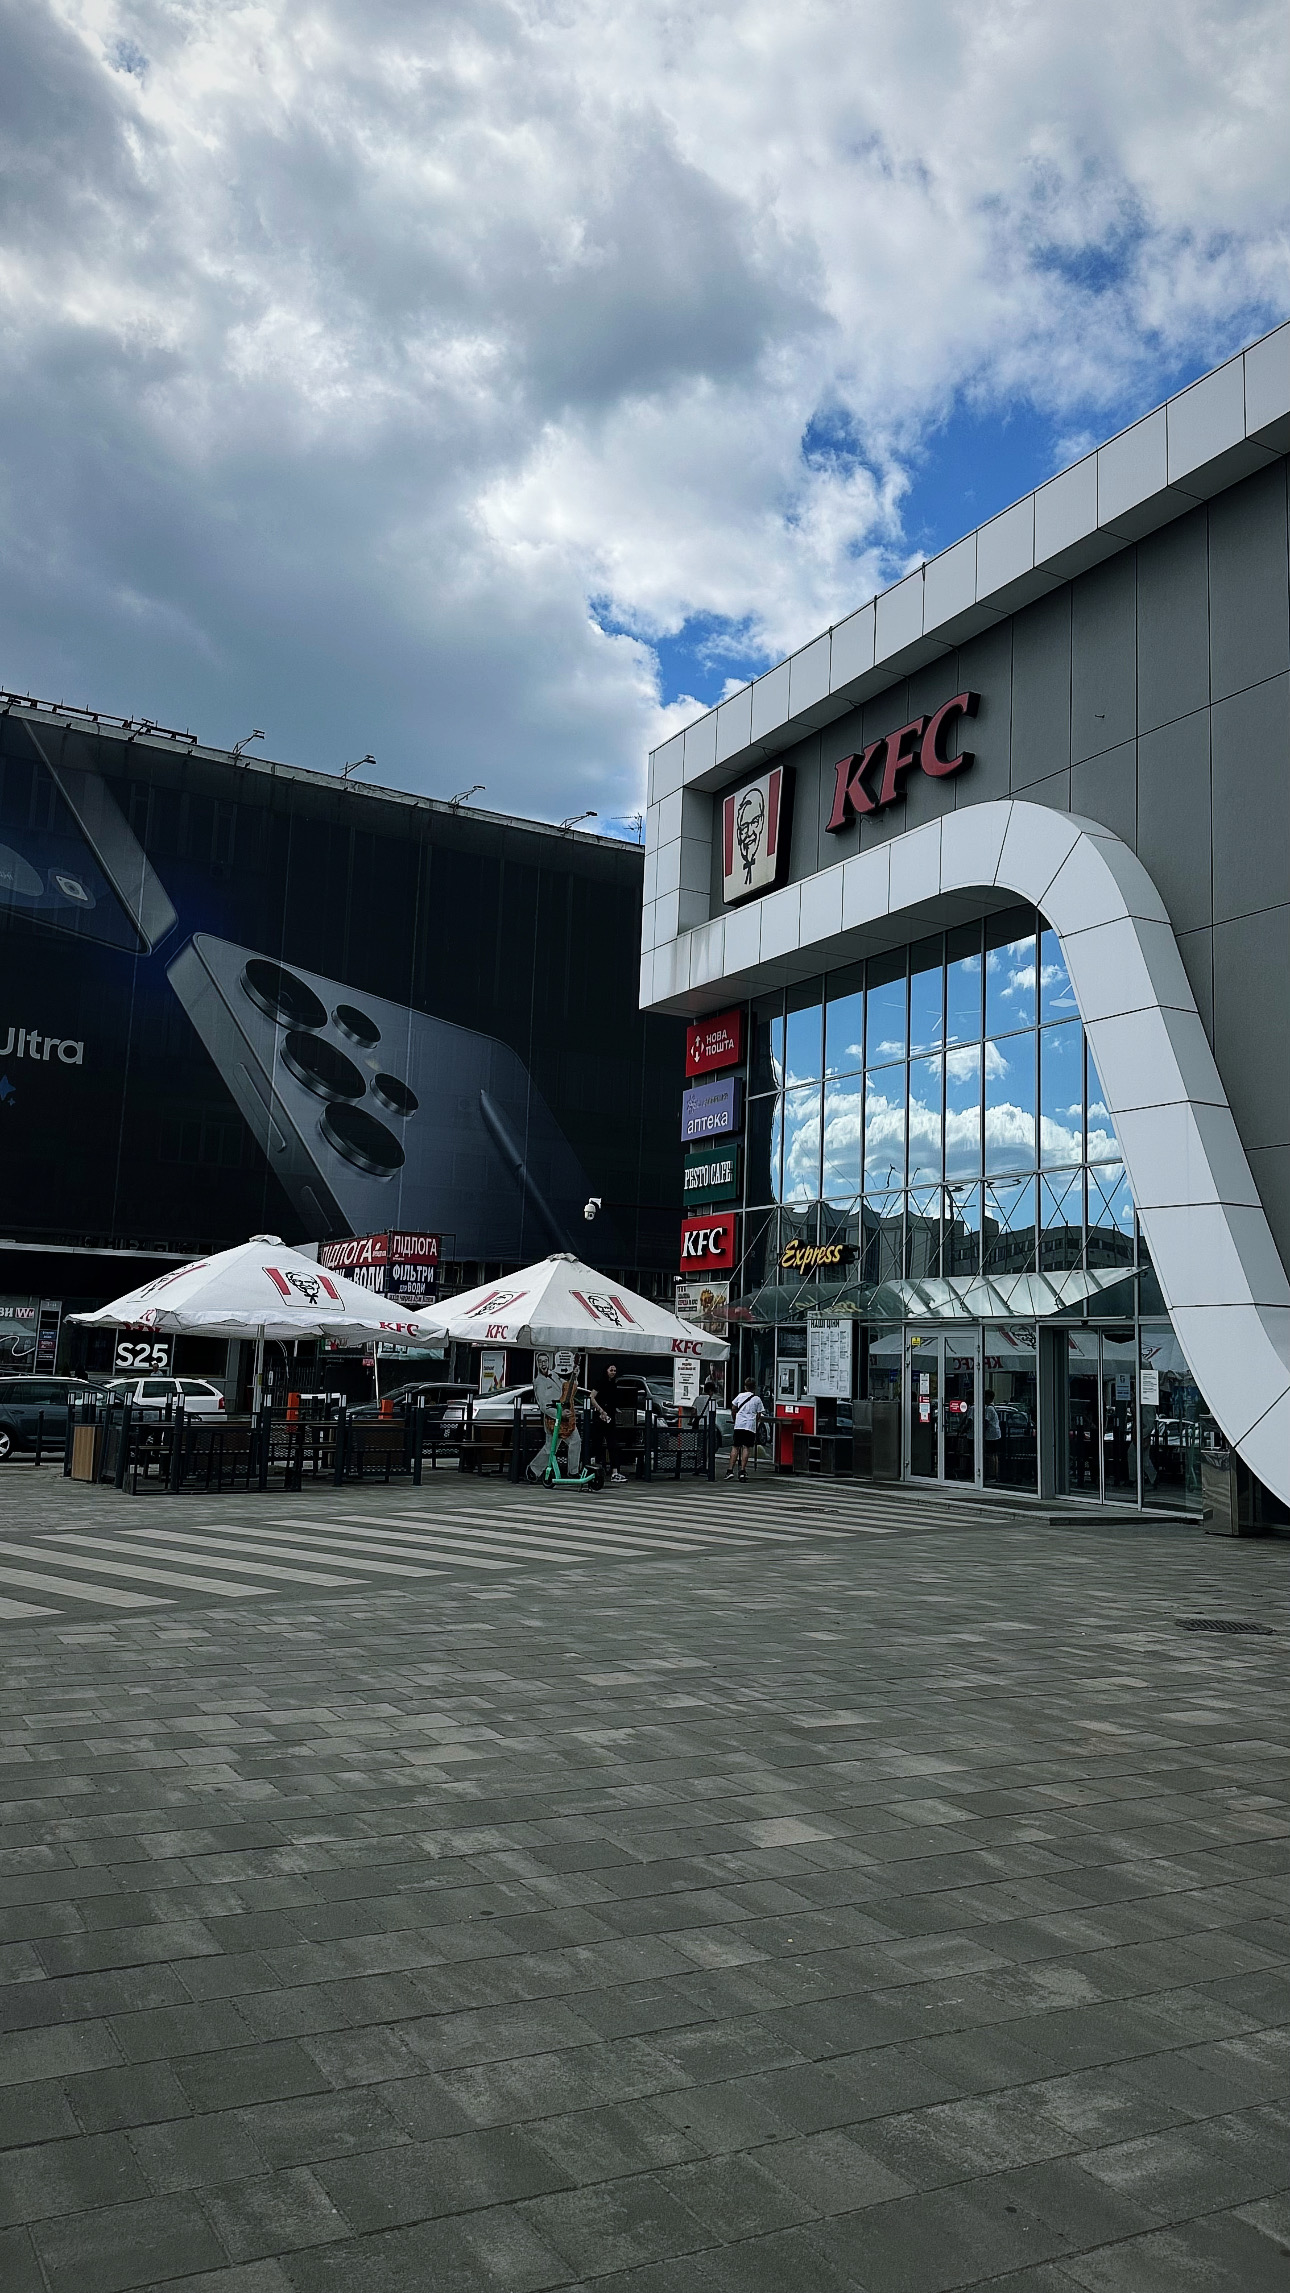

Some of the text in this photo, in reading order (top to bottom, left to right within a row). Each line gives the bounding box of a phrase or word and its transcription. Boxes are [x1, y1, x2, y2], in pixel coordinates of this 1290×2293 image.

[825, 690, 979, 833] KFC
[705, 1029, 728, 1045] НОВА
[705, 1038, 735, 1057] ПОШТА
[687, 1111, 728, 1135] аптека
[683, 1160, 733, 1190] PESTO CAFE
[322, 1238, 373, 1268] ПІДЛОГА
[393, 1235, 438, 1258] ПІДЛОГА
[681, 1226, 723, 1258] KFC
[781, 1238, 844, 1276] Express
[392, 1263, 434, 1283] ФІЛЬТРИ
[407, 1281, 426, 1295] ВОДИ
[379, 1321, 419, 1337] KFC
[485, 1324, 509, 1340] KFC
[115, 1342, 169, 1368] S25
[671, 1338, 704, 1356] KFC
